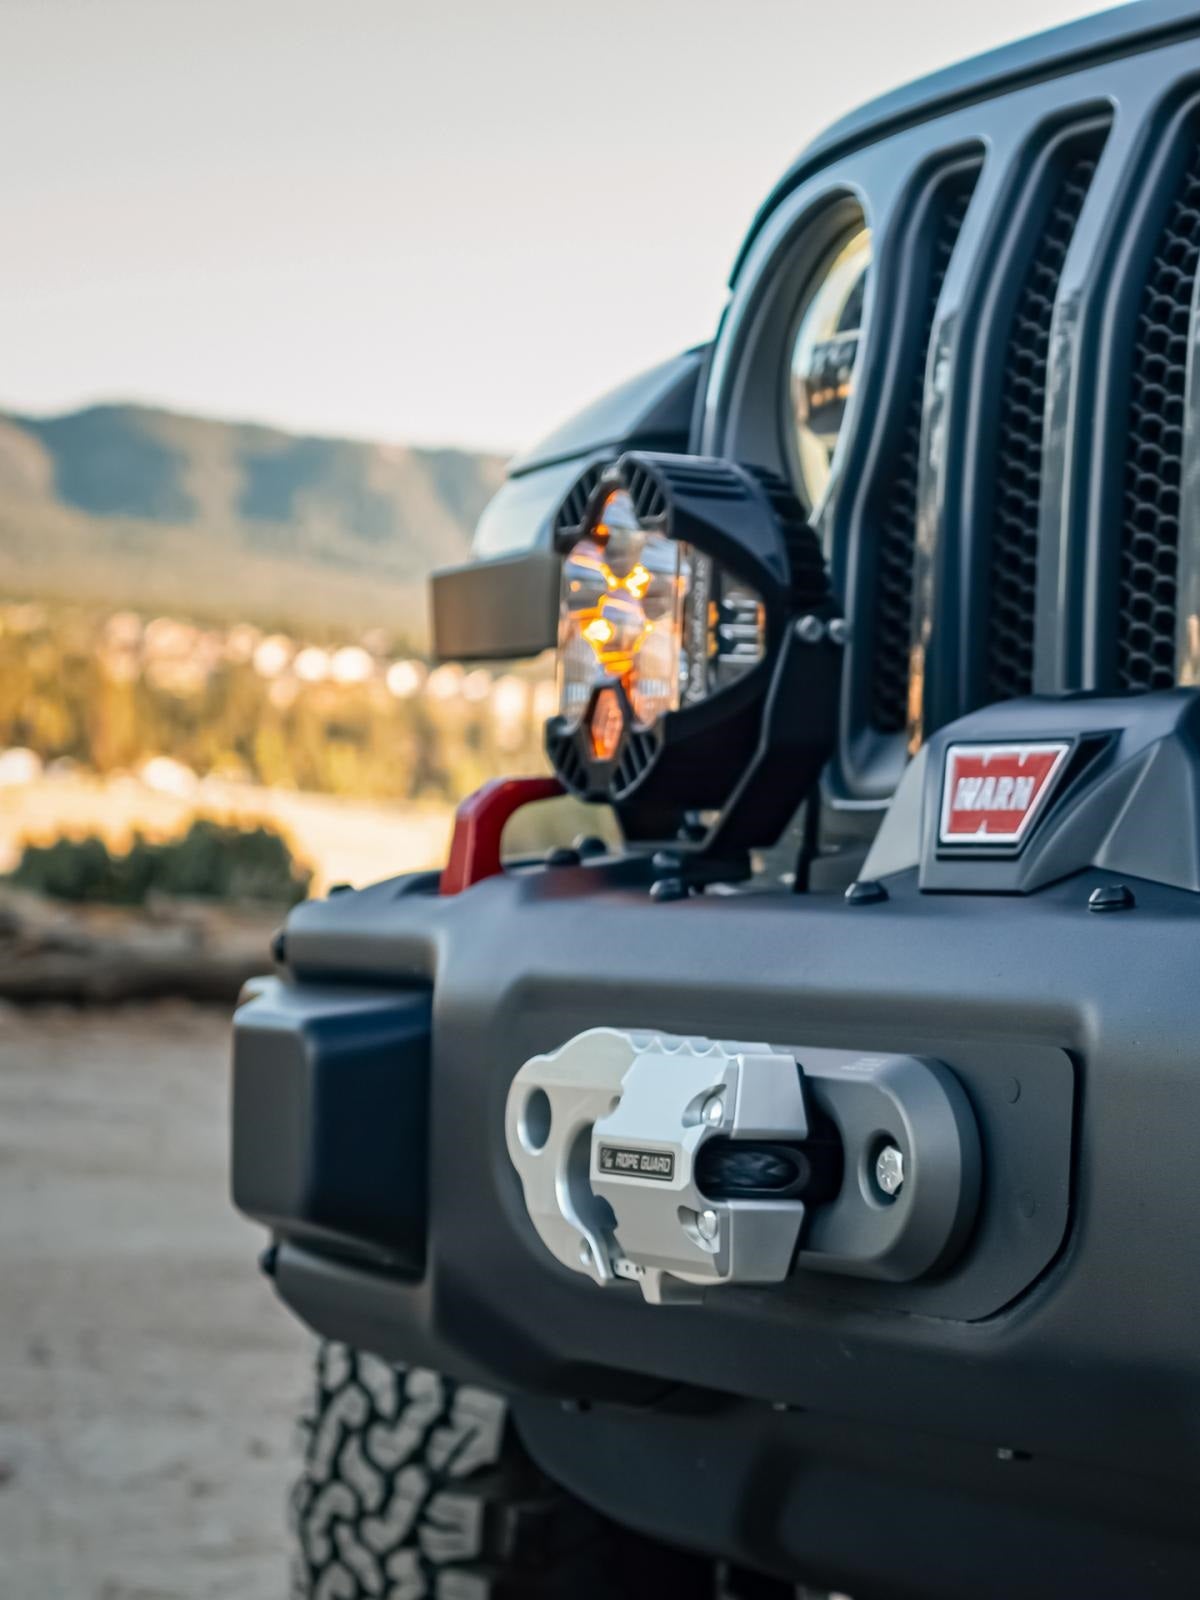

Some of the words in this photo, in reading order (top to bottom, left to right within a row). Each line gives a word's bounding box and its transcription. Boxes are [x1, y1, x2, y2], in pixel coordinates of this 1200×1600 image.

[953, 776, 1035, 811] WARN
[615, 1152, 640, 1170] ROPE
[640, 1155, 672, 1173] GUARD
